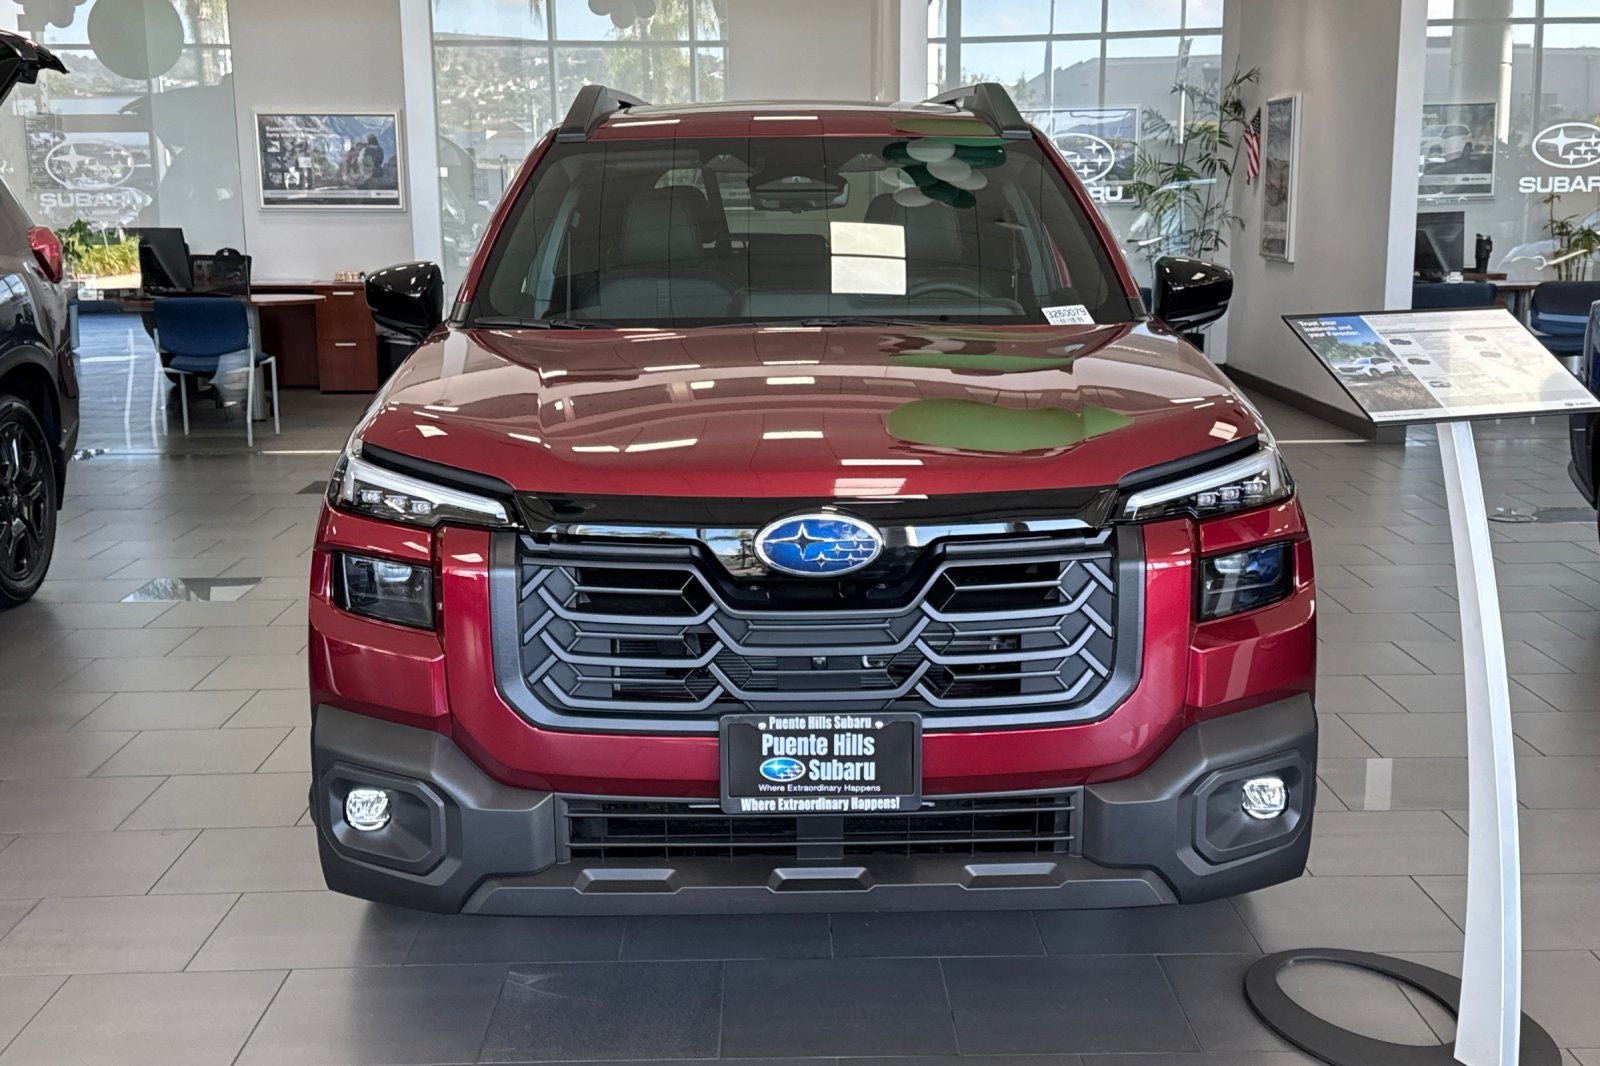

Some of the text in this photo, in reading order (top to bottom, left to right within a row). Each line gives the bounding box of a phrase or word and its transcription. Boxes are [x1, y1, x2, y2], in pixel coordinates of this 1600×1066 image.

[1518, 175, 1600, 193] SUBAR
[40, 192, 142, 208] SUBAR
[768, 715, 872, 730] Puente Hills Subaru
[762, 732, 875, 756] Puente Hills
[808, 759, 876, 781] Subaru
[758, 784, 881, 793] Where Extraordinary Happens
[740, 796, 901, 812] Where Extraordinary Happens!
